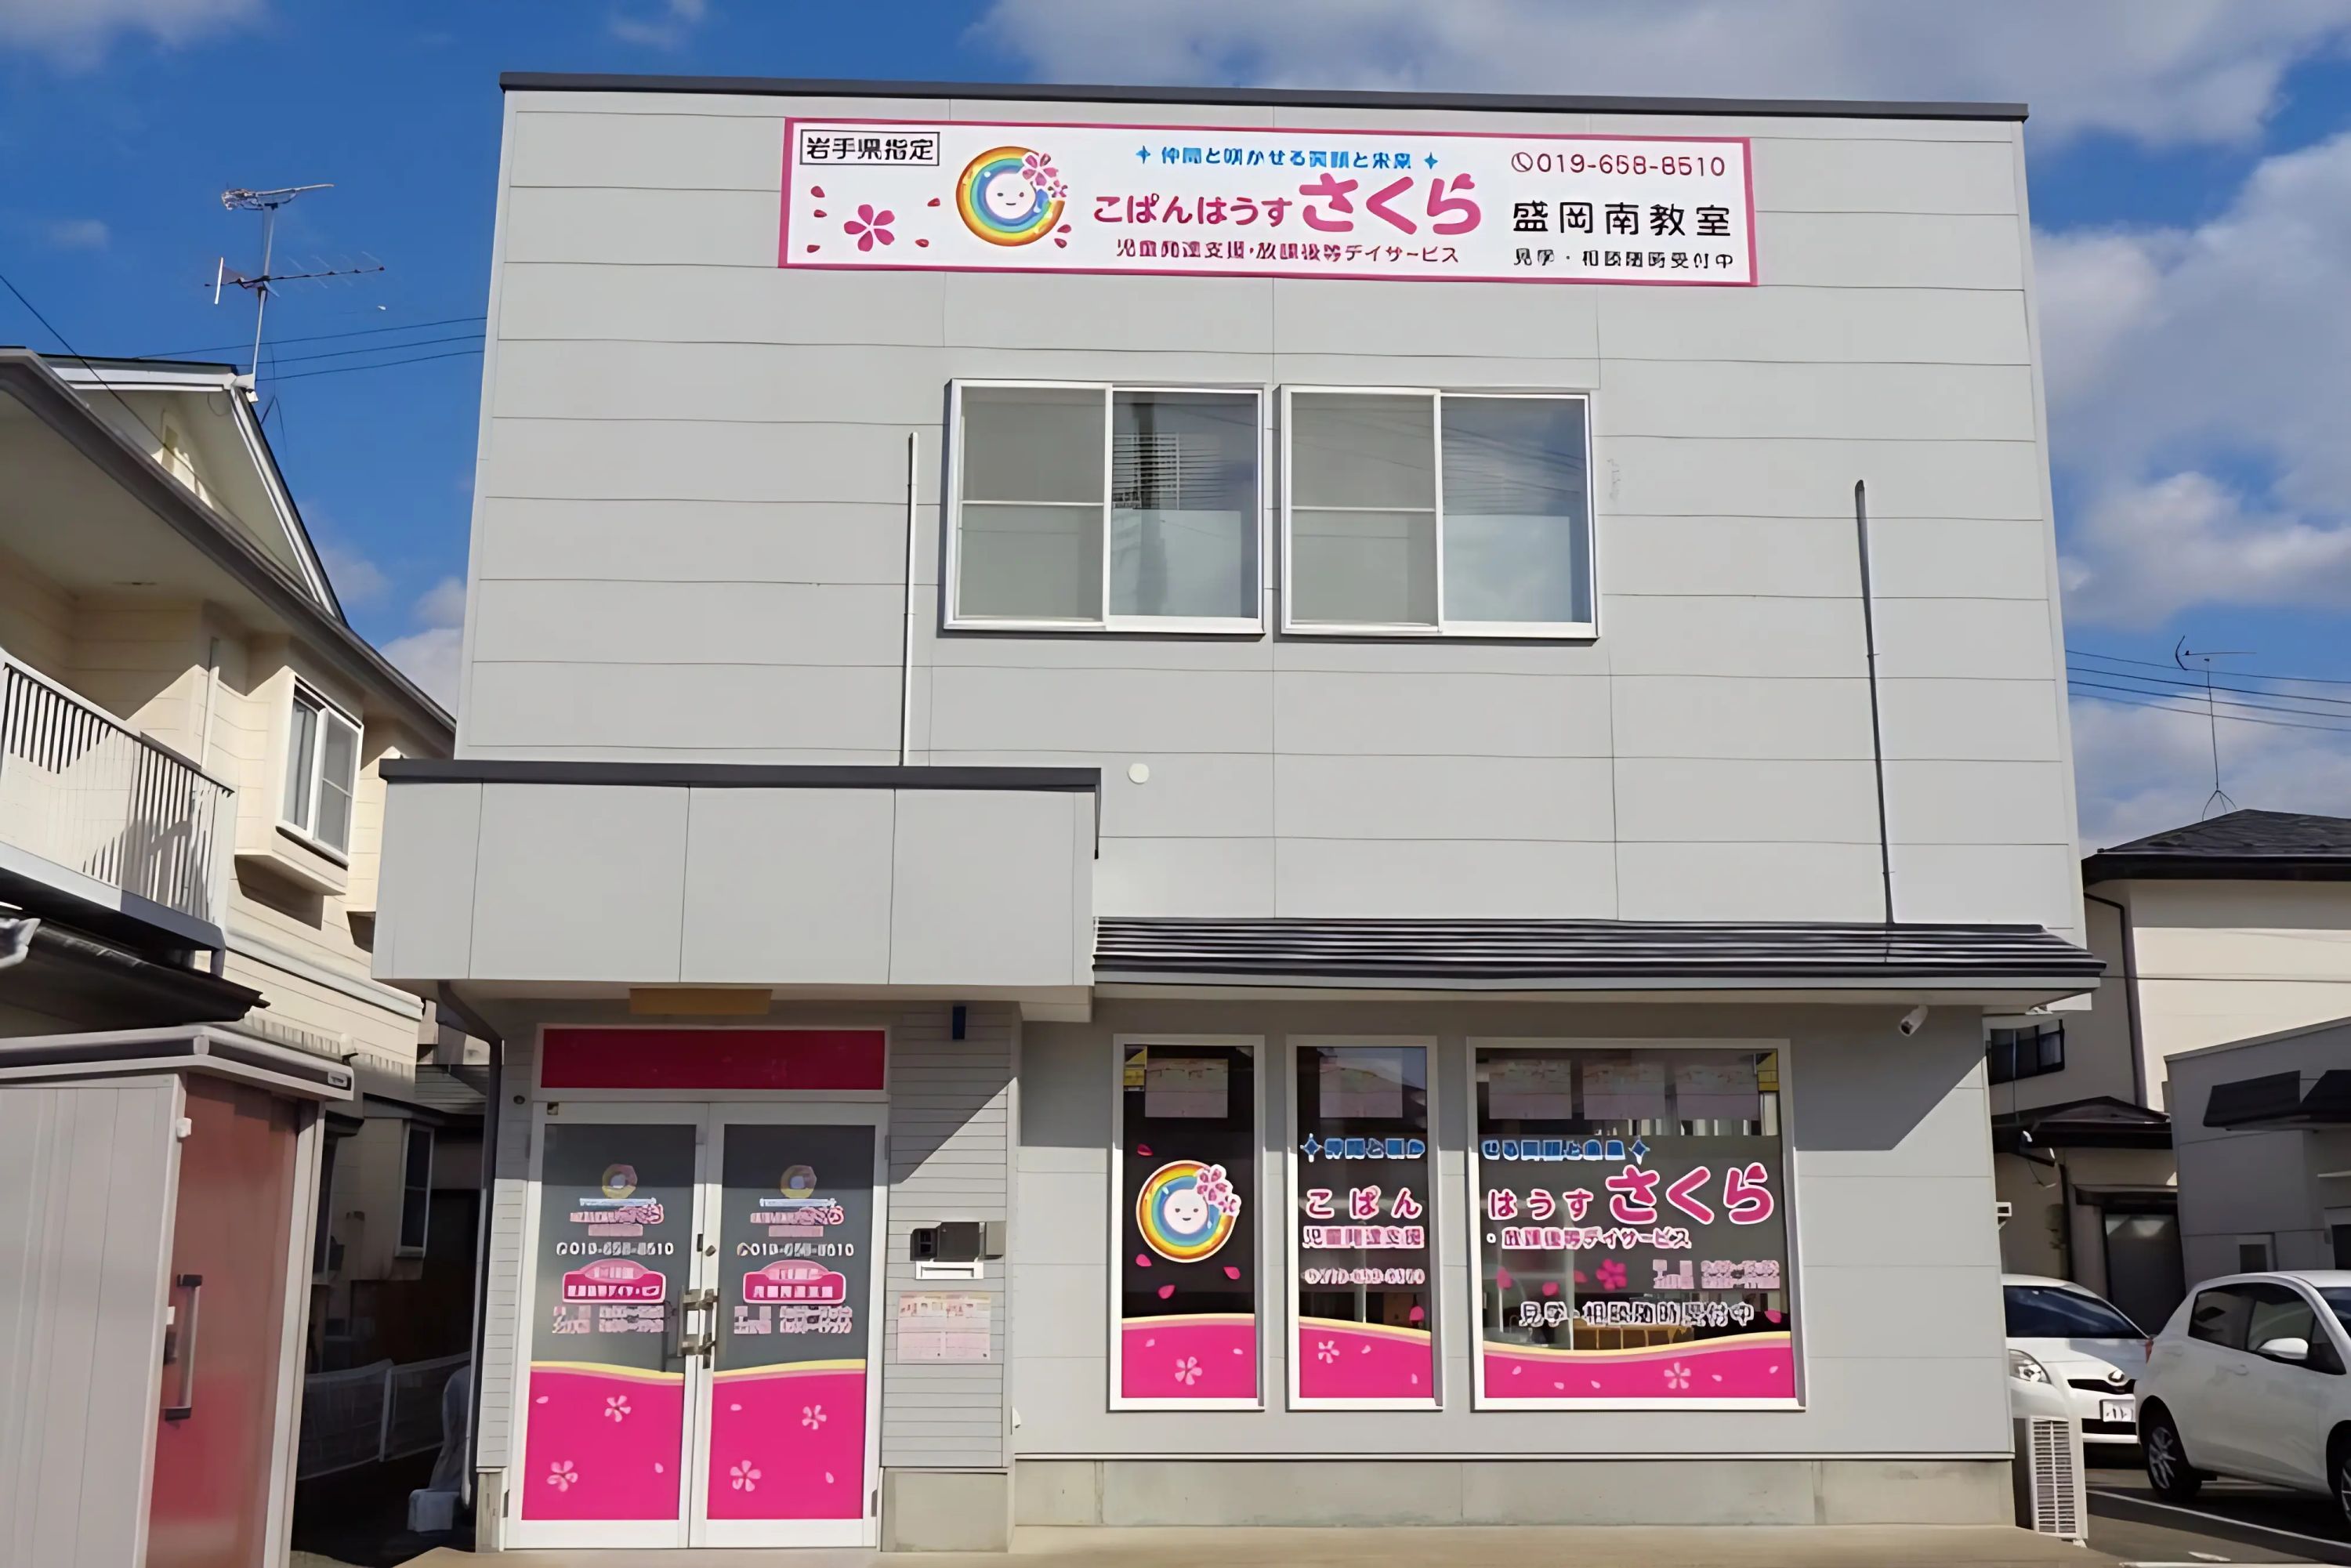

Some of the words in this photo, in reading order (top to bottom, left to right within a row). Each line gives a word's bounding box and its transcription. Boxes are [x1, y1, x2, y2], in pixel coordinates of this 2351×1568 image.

[807, 137, 933, 160] 岩手県指定
[1537, 153, 1726, 177] 019-658-8510
[1513, 200, 1730, 236] 盛岡南教室
